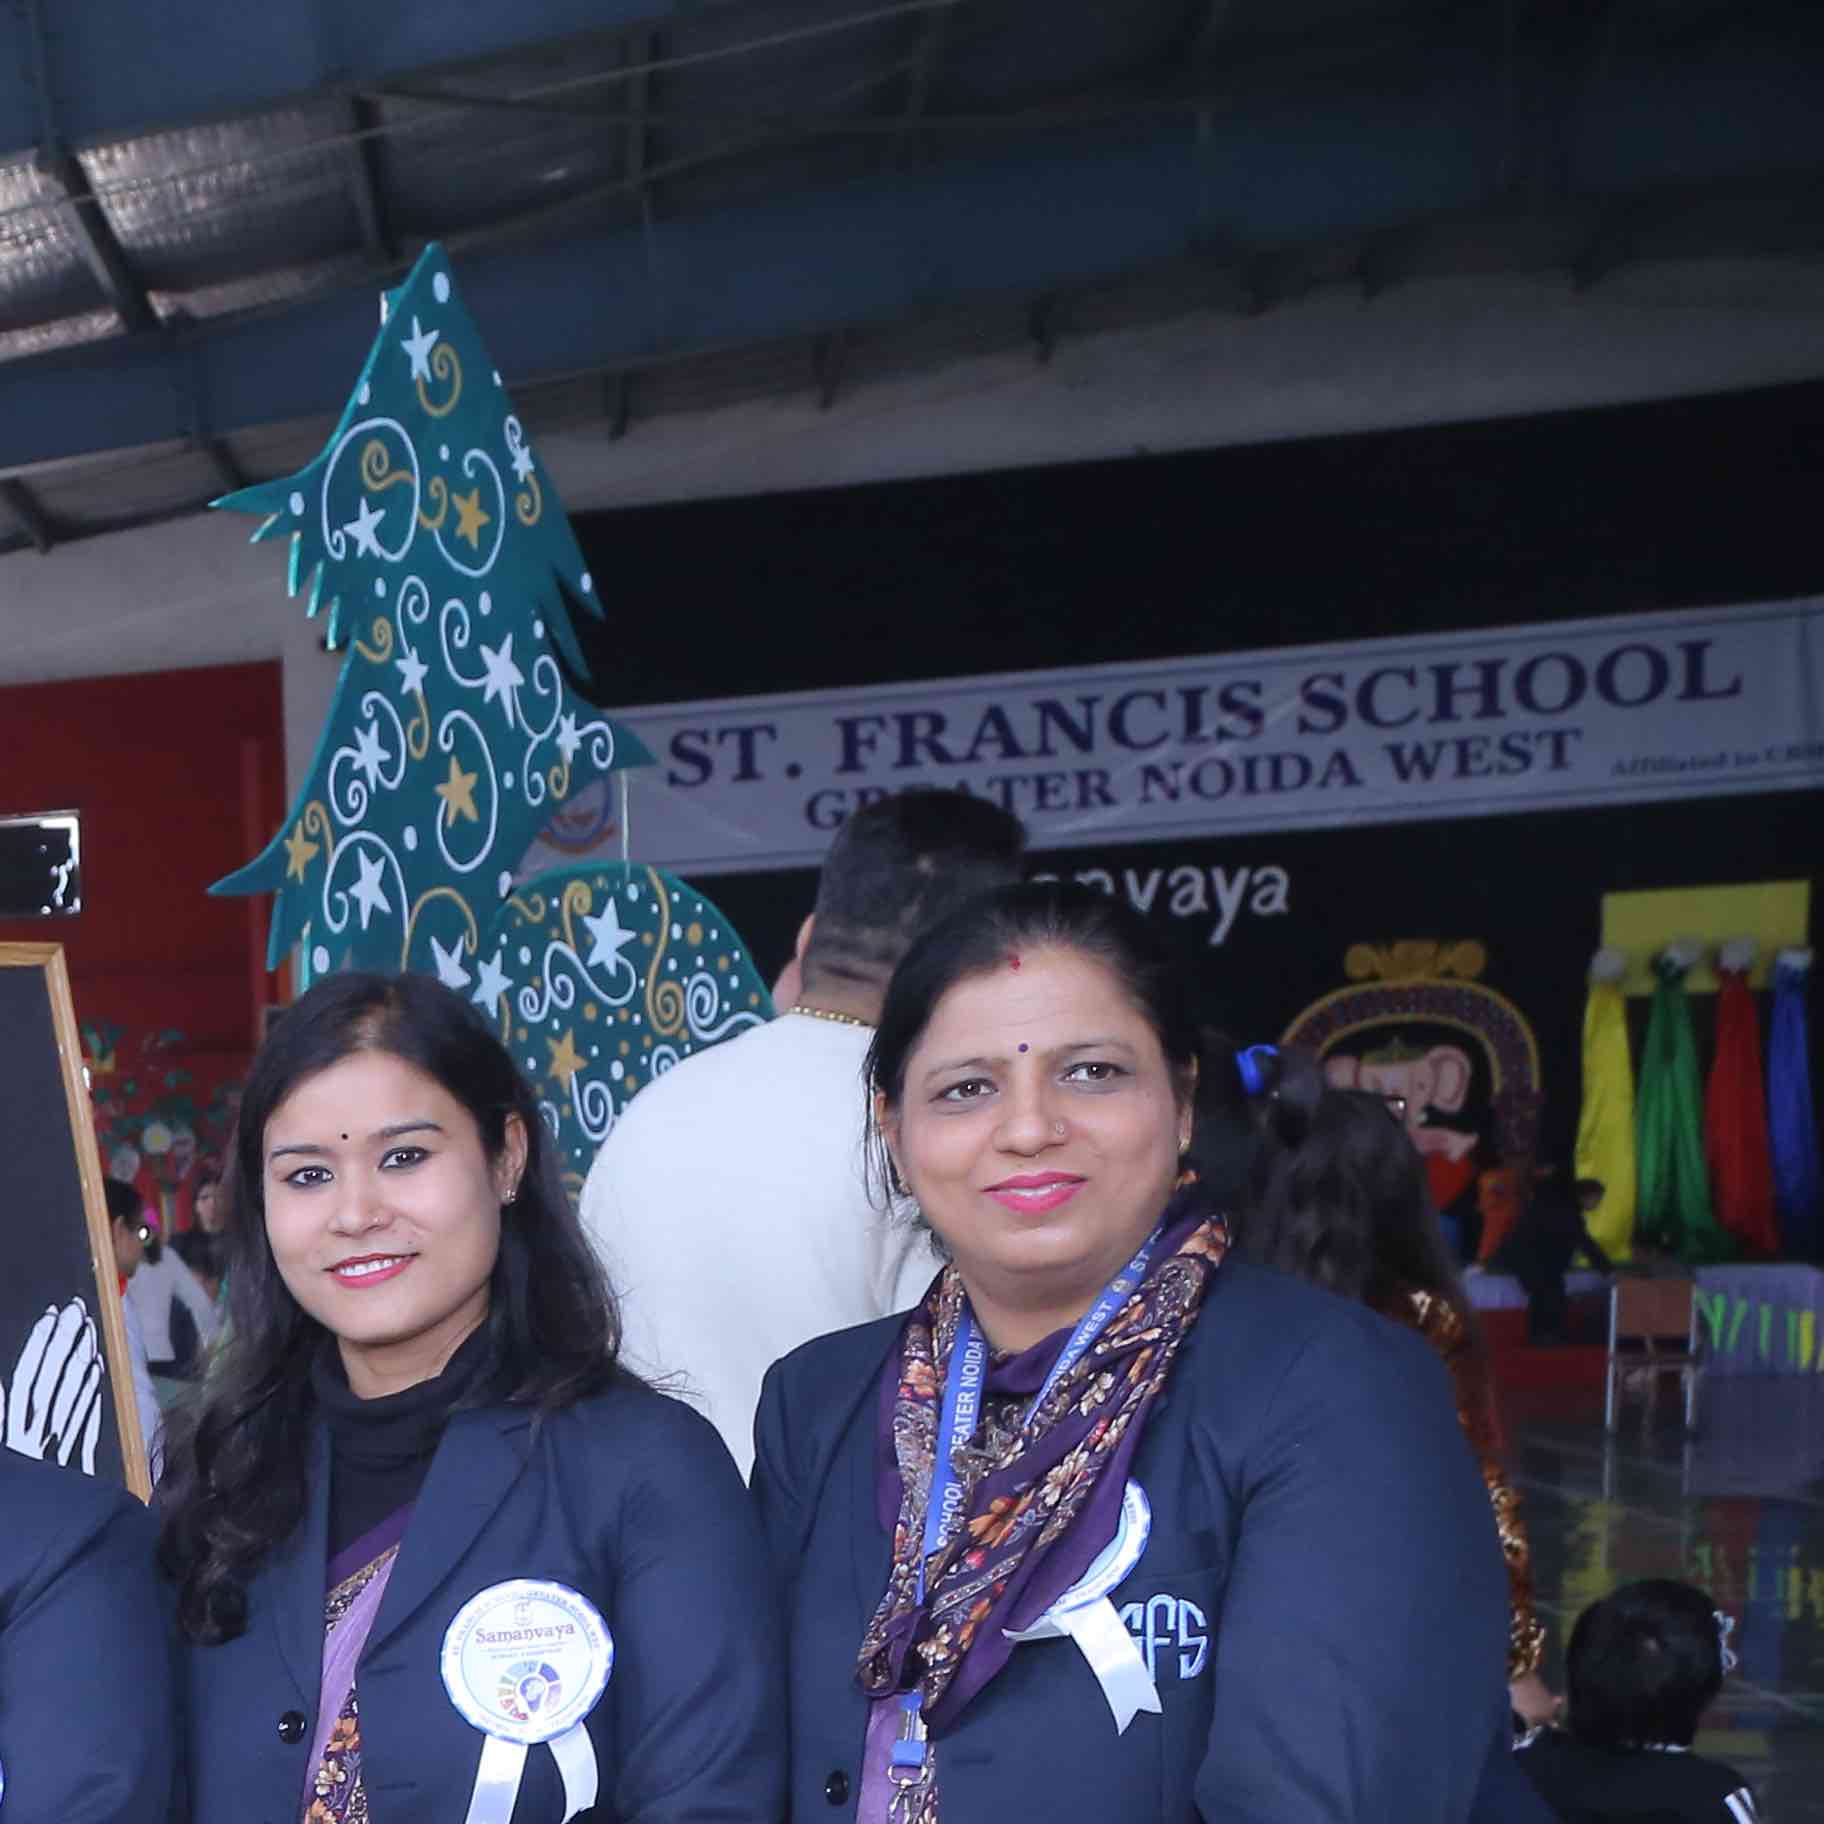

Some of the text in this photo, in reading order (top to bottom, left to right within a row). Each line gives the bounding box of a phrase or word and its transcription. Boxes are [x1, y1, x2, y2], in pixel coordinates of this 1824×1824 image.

[666, 638, 1742, 788] ST. FRANCIS SCHOOL
[804, 728, 1584, 831] GTER NOIDA WEST
[1076, 1301, 1113, 1347] WEST
[960, 1339, 985, 1392] NOIDA
[475, 1623, 576, 1645] Samanvaya
